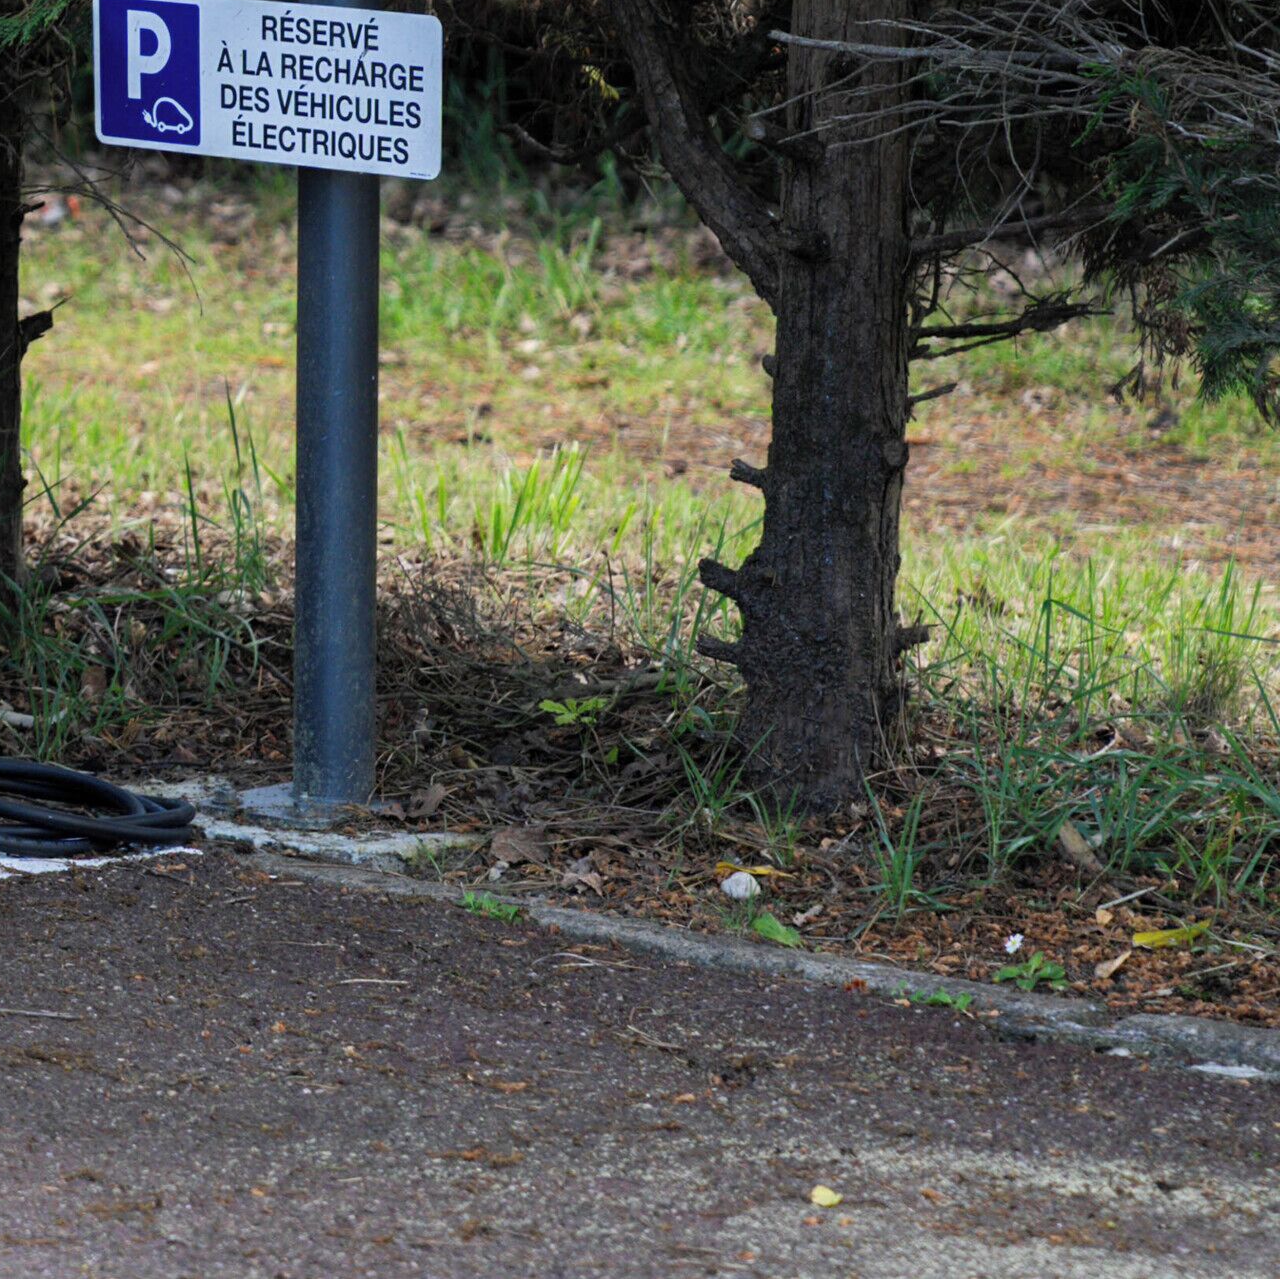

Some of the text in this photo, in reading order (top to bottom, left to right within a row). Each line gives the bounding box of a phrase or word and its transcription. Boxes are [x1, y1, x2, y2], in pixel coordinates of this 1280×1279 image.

[127, 9, 171, 99] P
[261, 10, 379, 51] RÉSERVÉ
[217, 40, 424, 92] À LA RECHARGE
[221, 83, 421, 128] DES VÉHICULES
[232, 116, 409, 165] ÉLECTRIQUES
